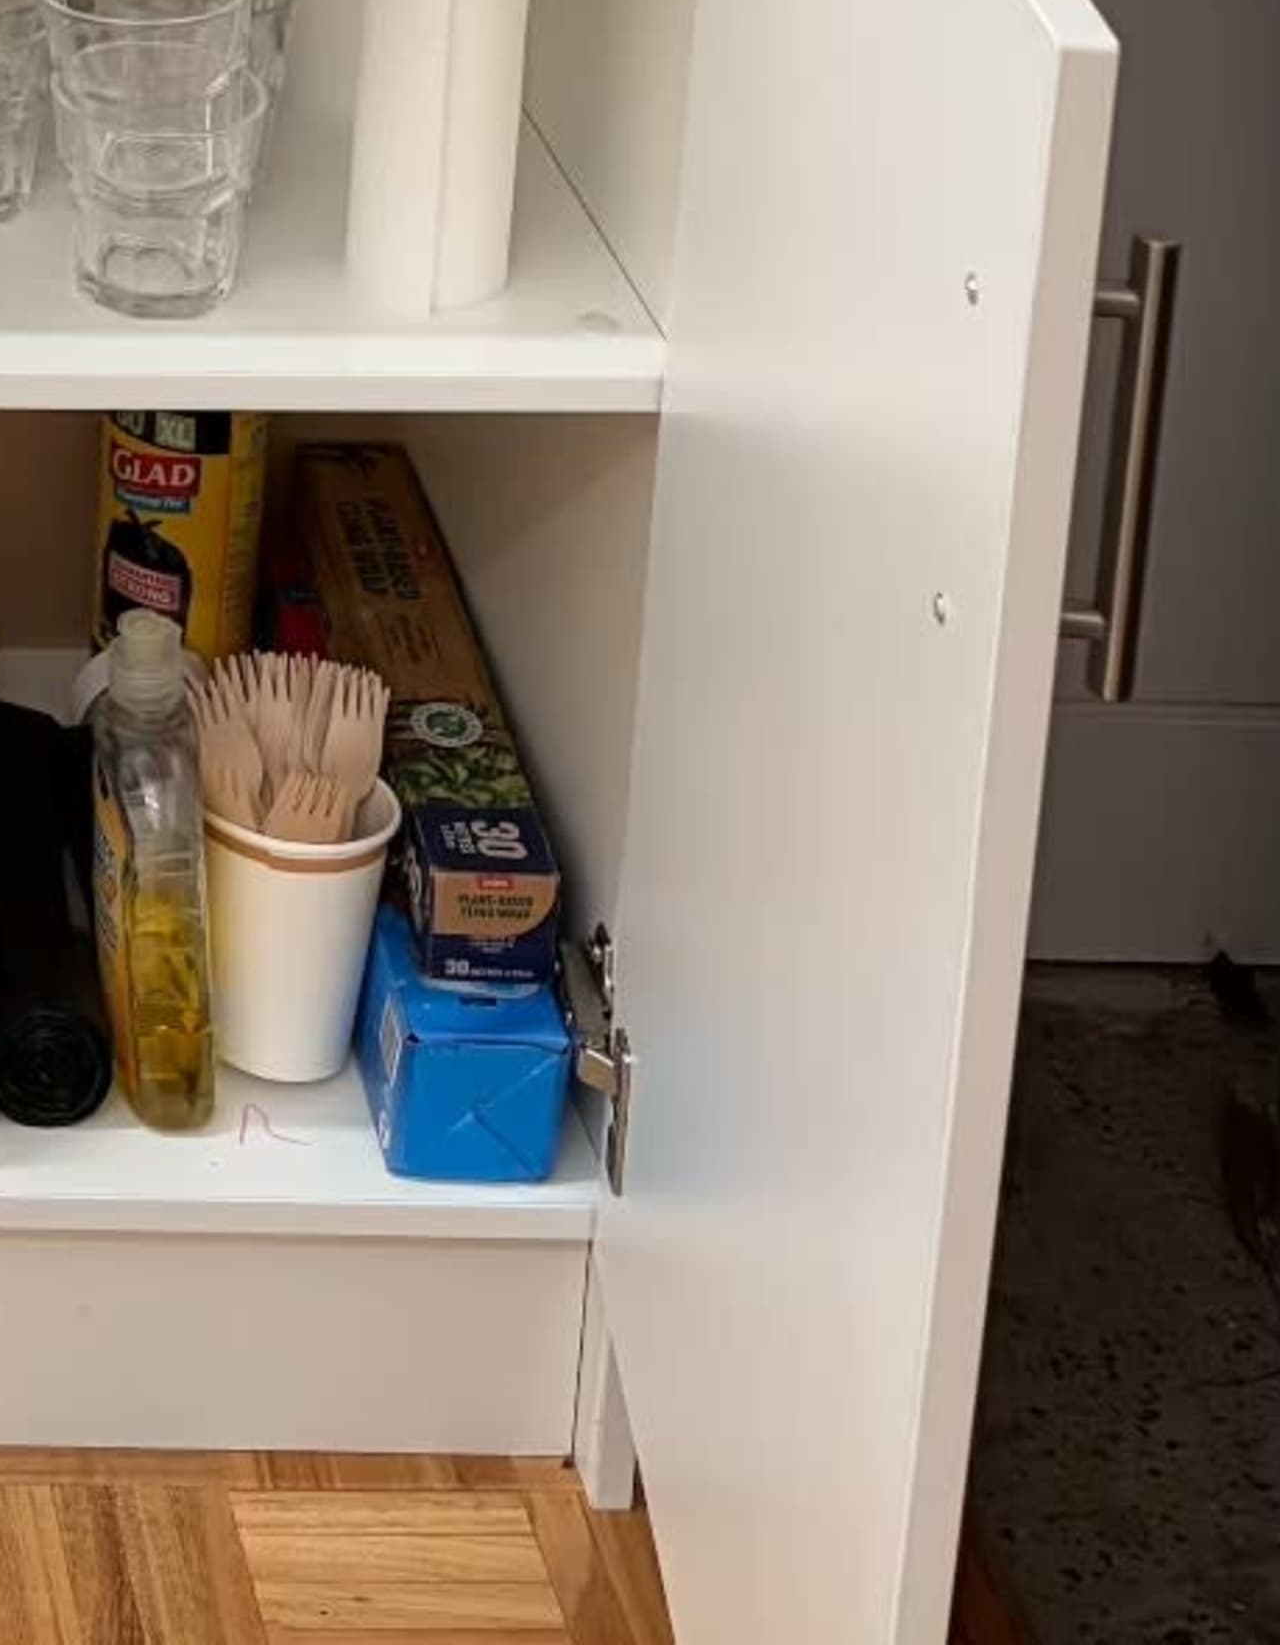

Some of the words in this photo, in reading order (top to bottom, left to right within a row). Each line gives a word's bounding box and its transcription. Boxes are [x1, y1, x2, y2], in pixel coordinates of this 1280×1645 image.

[112, 449, 196, 487] GLAD
[470, 819, 529, 861] 30
[443, 957, 471, 976] 30
